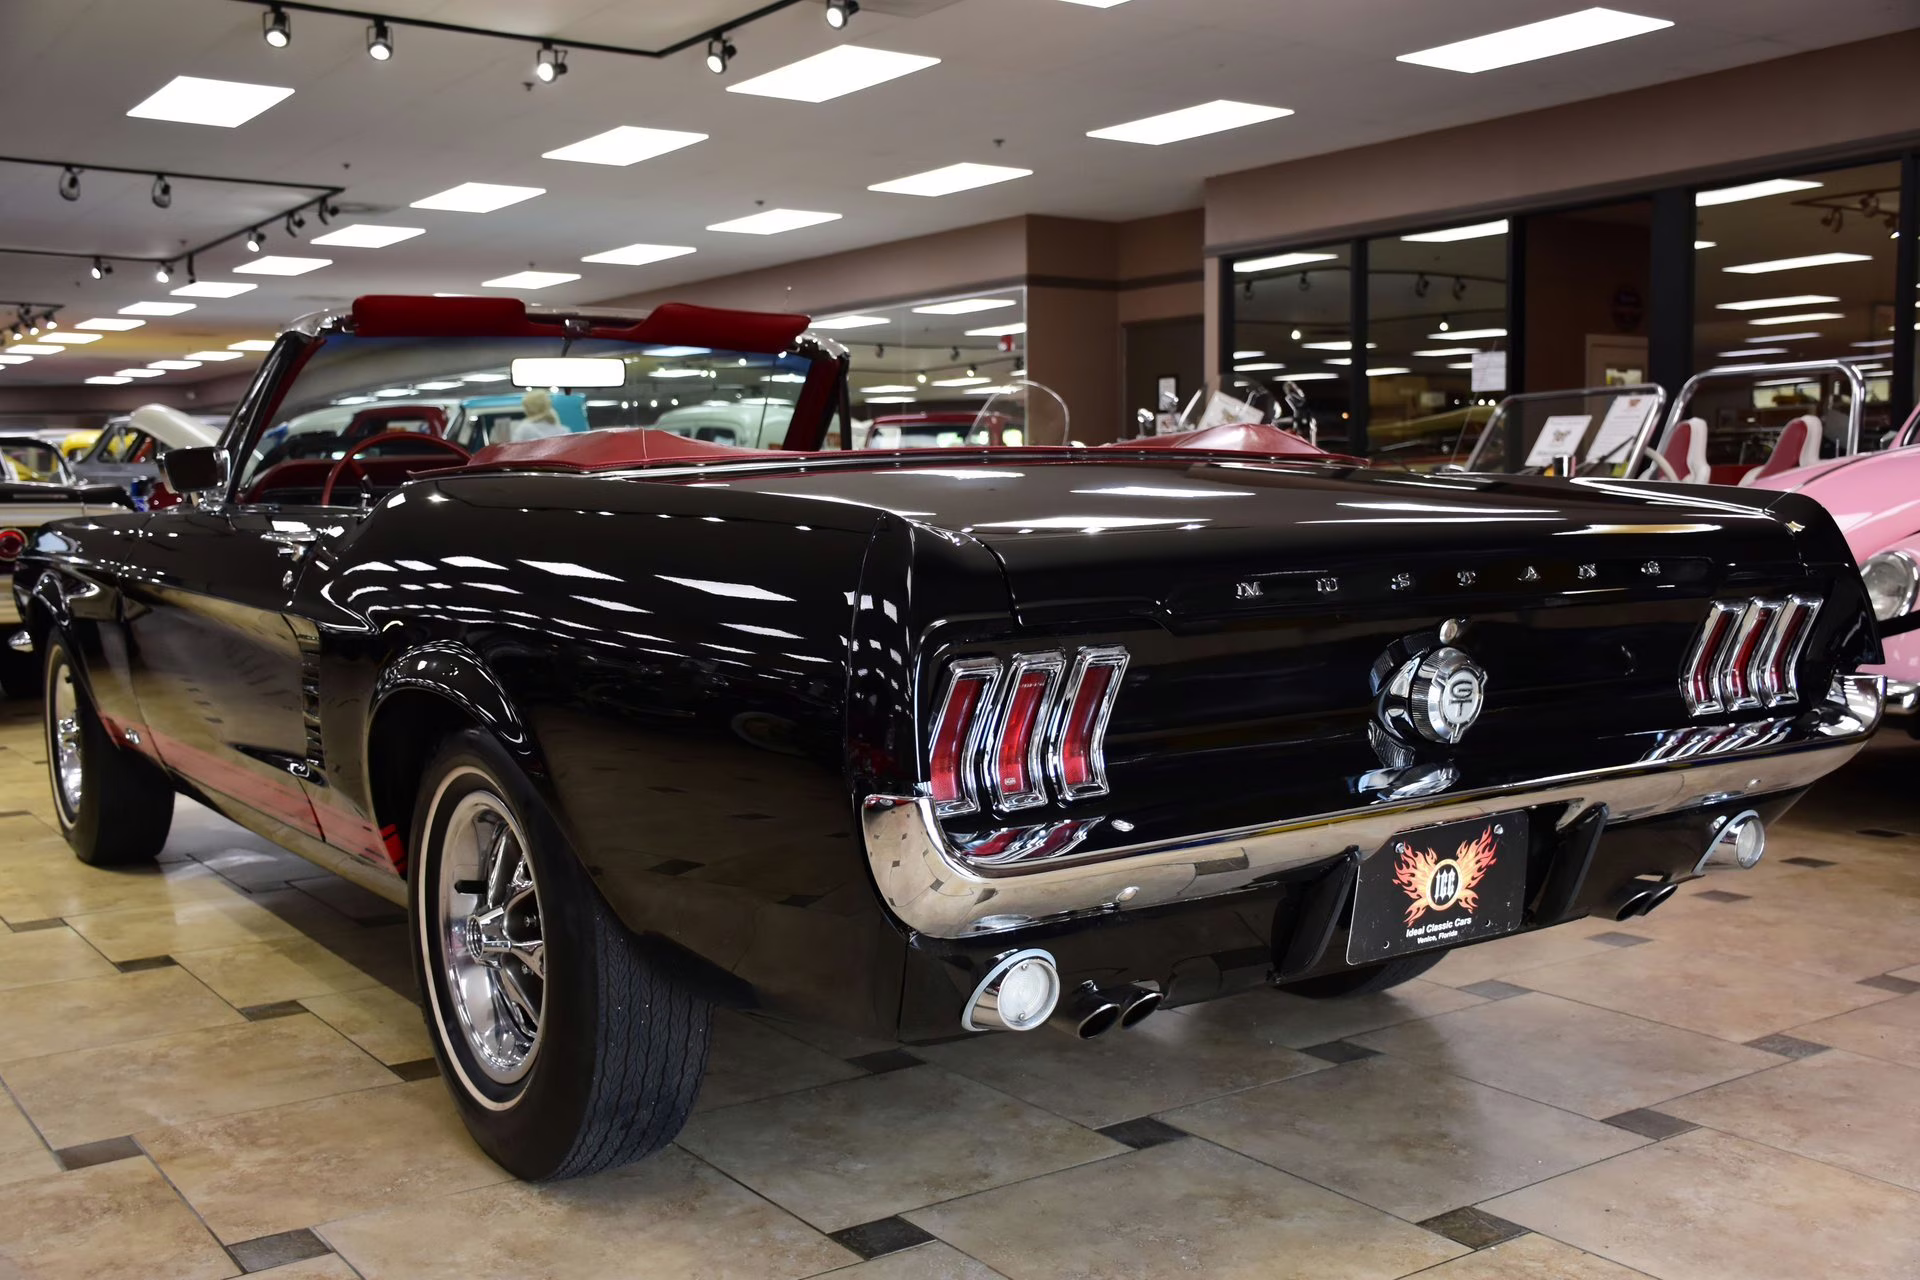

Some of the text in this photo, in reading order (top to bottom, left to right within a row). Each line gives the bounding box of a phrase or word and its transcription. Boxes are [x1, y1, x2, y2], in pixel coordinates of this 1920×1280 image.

[1237, 560, 1660, 599] MUSTANG
[1449, 680, 1473, 717] GT
[1406, 918, 1472, 937] Ideal Classic Cars
[1417, 930, 1458, 944] Venice, Florida
